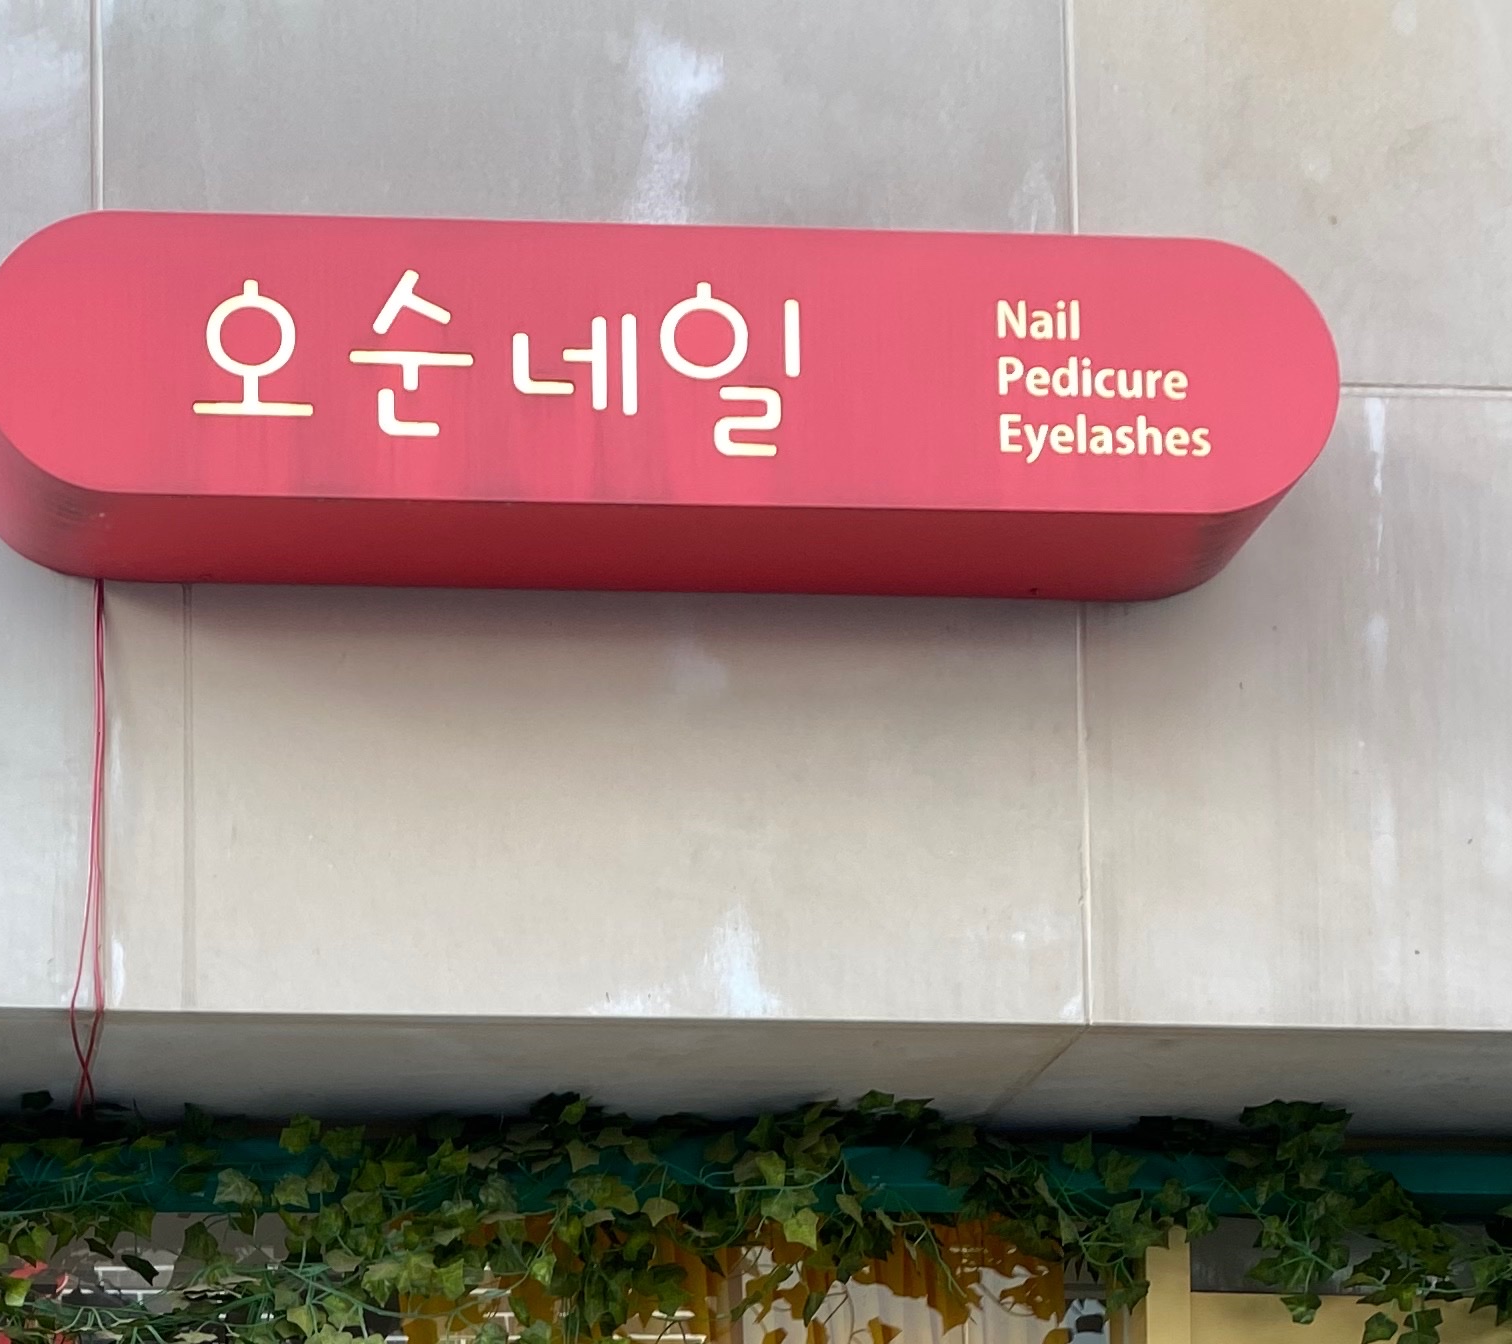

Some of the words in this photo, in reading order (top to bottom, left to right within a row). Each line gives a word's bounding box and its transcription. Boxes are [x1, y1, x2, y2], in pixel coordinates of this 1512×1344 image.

[997, 299, 1081, 341] Nail
[192, 269, 801, 457] 오순네일
[997, 356, 1189, 400] Pedicure
[998, 412, 1212, 464] Eyelashes
